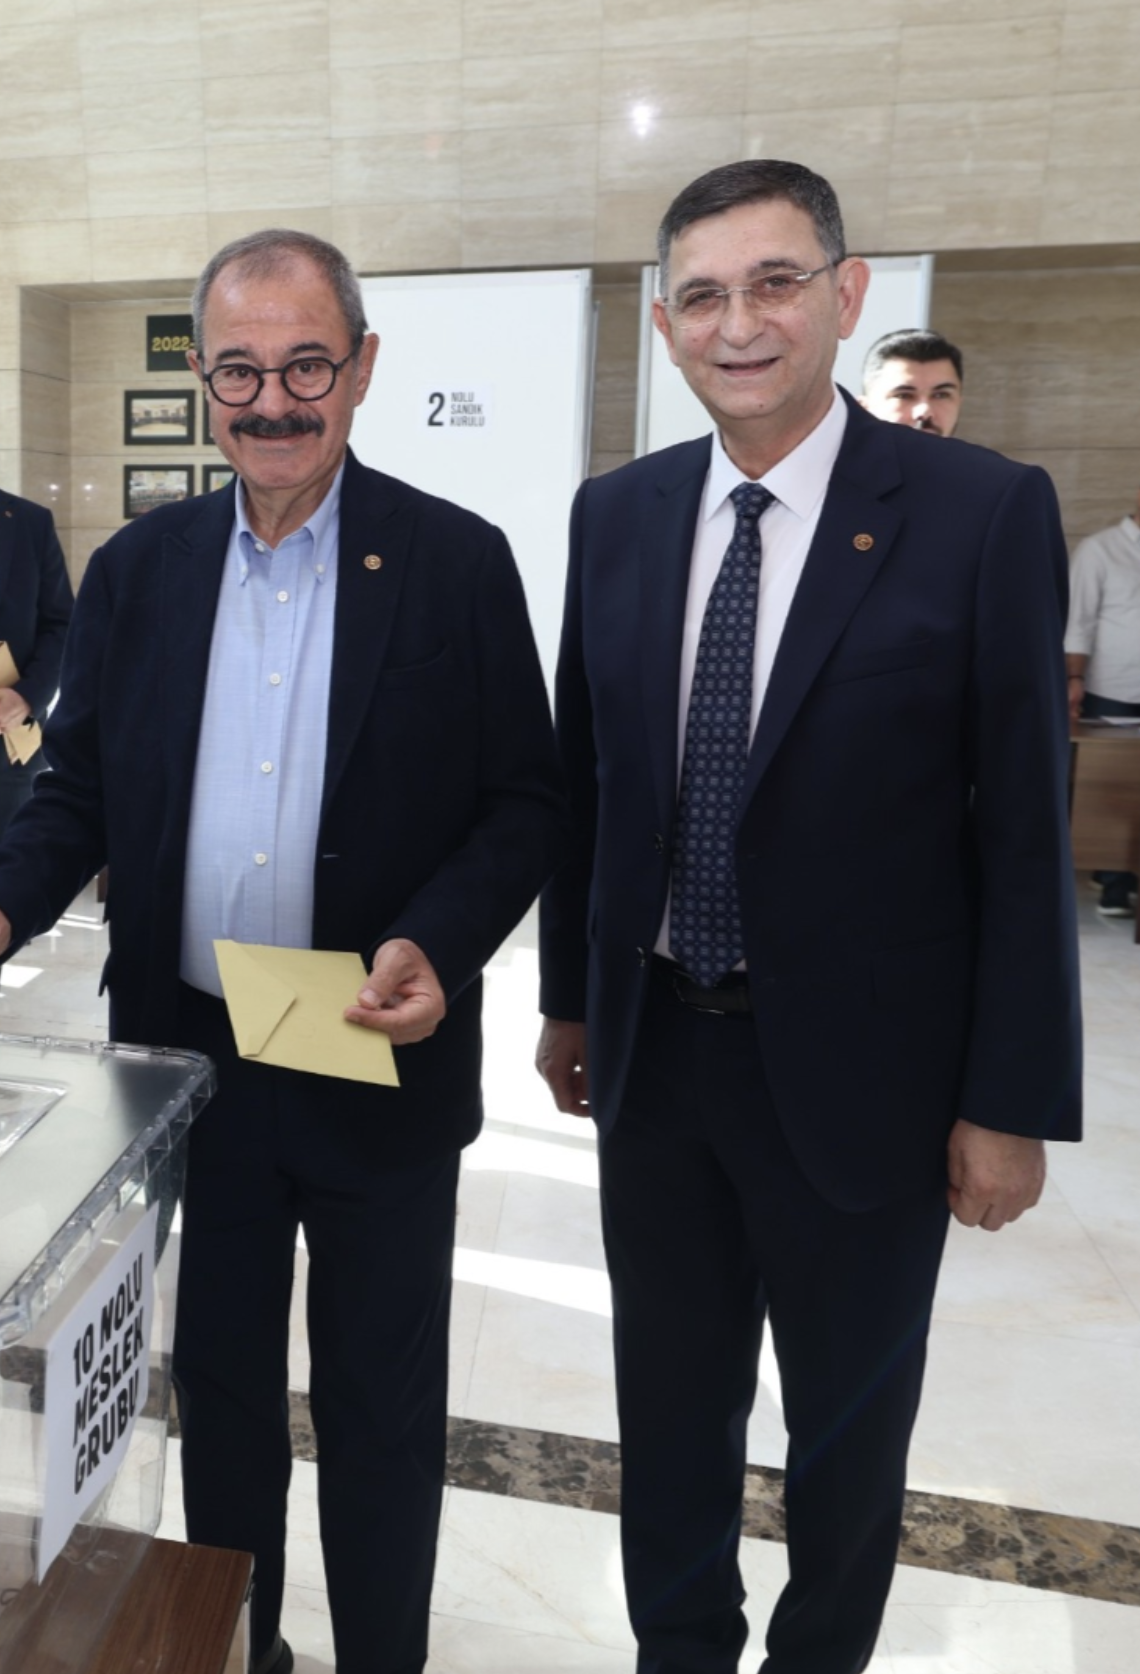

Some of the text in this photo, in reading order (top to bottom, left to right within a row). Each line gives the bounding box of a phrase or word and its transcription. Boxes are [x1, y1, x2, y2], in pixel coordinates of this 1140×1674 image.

[427, 391, 445, 427] 2
[450, 391, 475, 403] NOLU
[450, 403, 484, 415] SANDIK
[449, 415, 485, 427] KURULU
[73, 1251, 144, 1388] 10 NOLU
[72, 1305, 144, 1449] MESLEK
[73, 1367, 140, 1495] GRUBU
